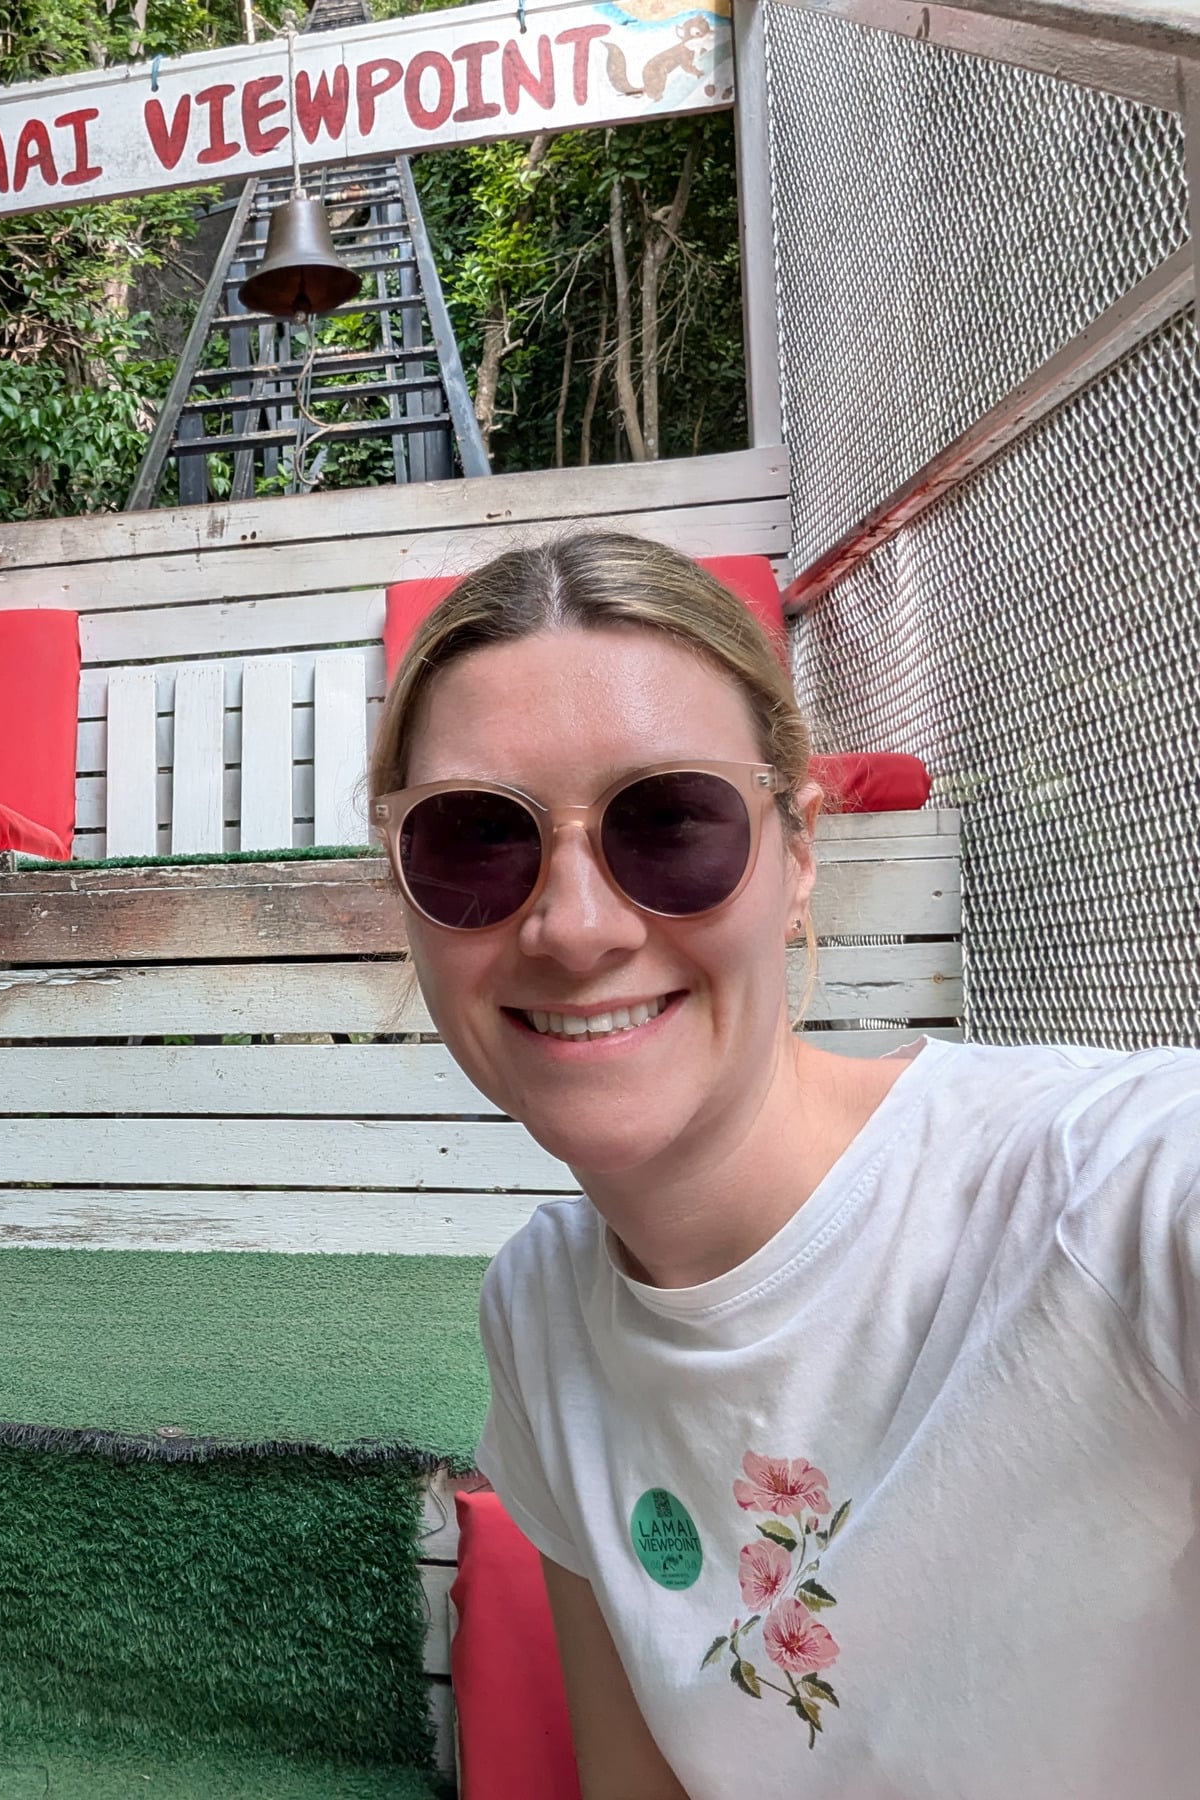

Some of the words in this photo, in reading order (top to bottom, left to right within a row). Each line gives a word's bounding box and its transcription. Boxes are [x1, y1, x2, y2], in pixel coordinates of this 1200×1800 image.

[145, 24, 611, 170] VIEWPOINT
[638, 1520, 693, 1538] LAMAI
[638, 1538, 700, 1552] VIEWPOINT
